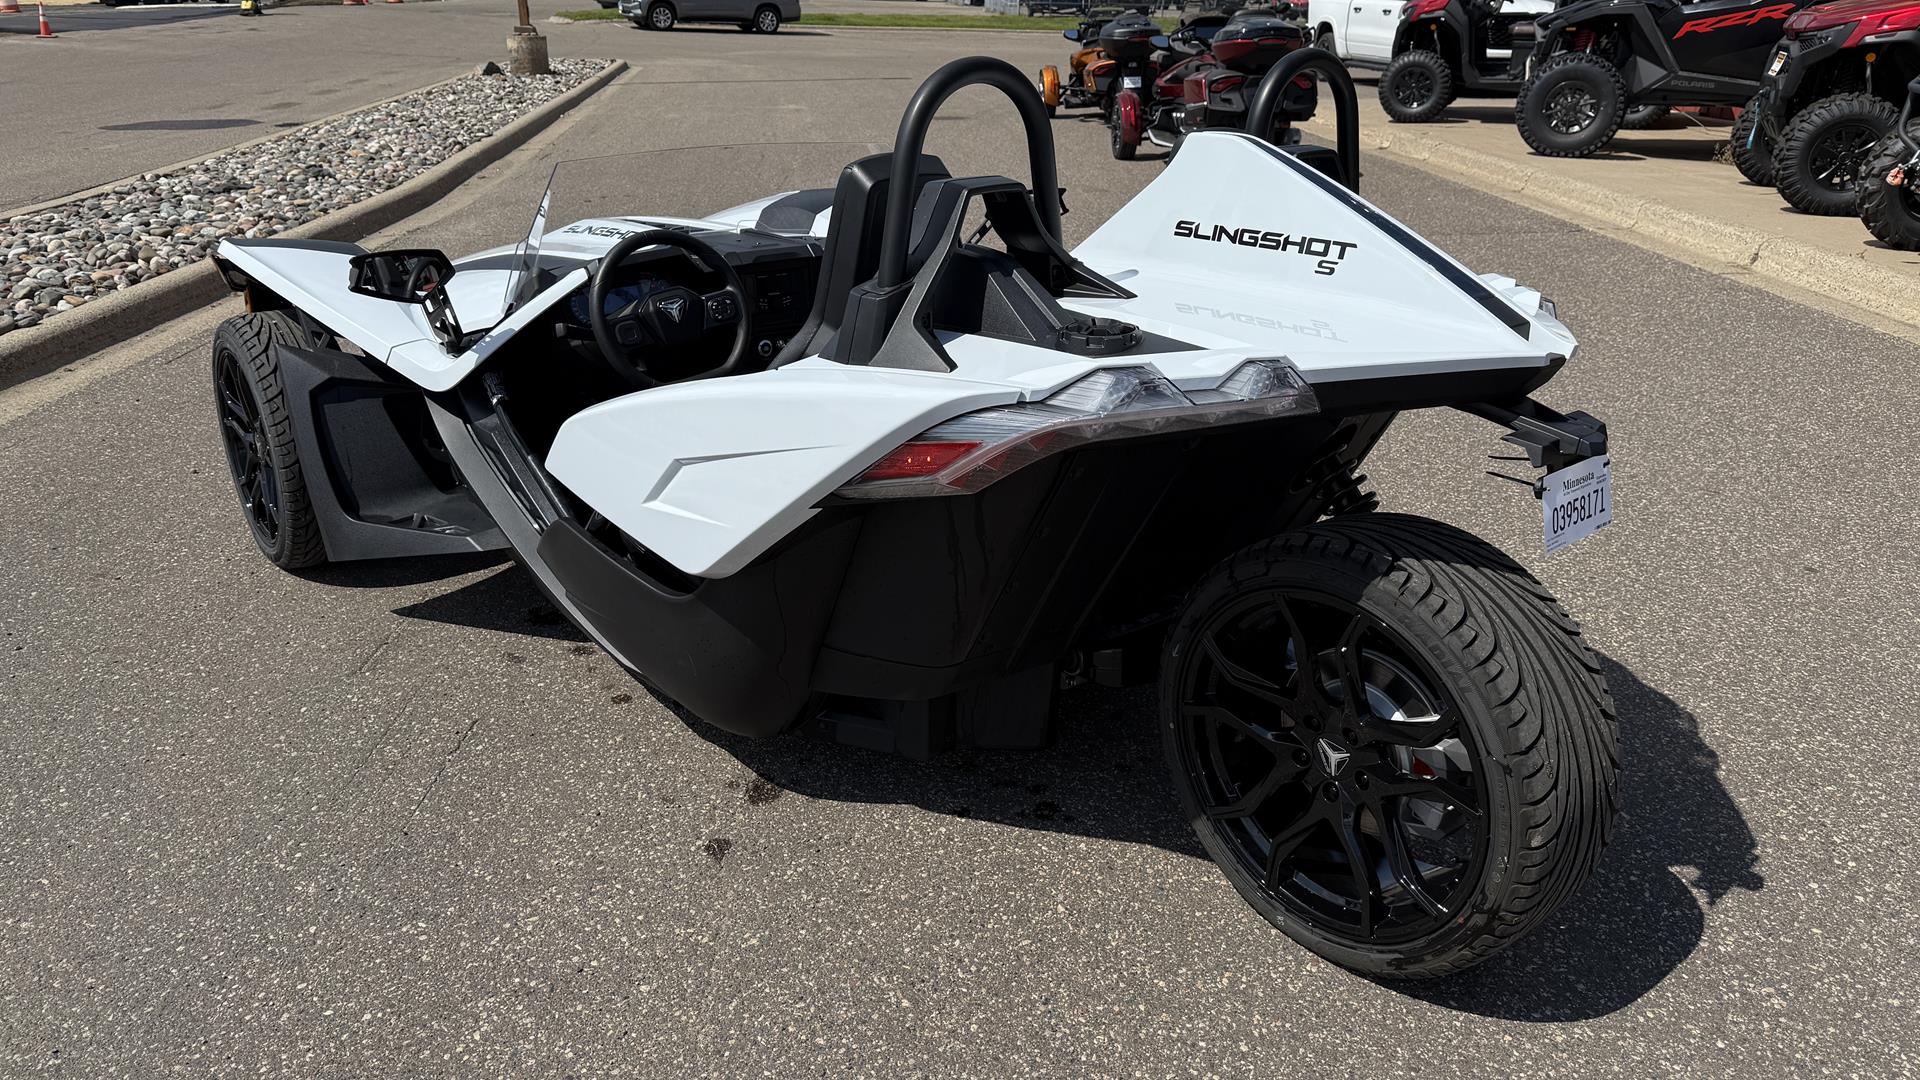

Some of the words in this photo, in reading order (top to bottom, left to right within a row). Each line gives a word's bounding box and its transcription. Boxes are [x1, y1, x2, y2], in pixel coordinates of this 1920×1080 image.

[1672, 3, 1796, 40] RZR
[1670, 79, 1716, 89] POLARIS
[562, 225, 638, 240] SLINGSHO
[1174, 220, 1358, 260] SLINGSHOT
[1314, 259, 1339, 276] S
[1562, 472, 1594, 492] Minnesota
[1552, 487, 1605, 534] 03958171
